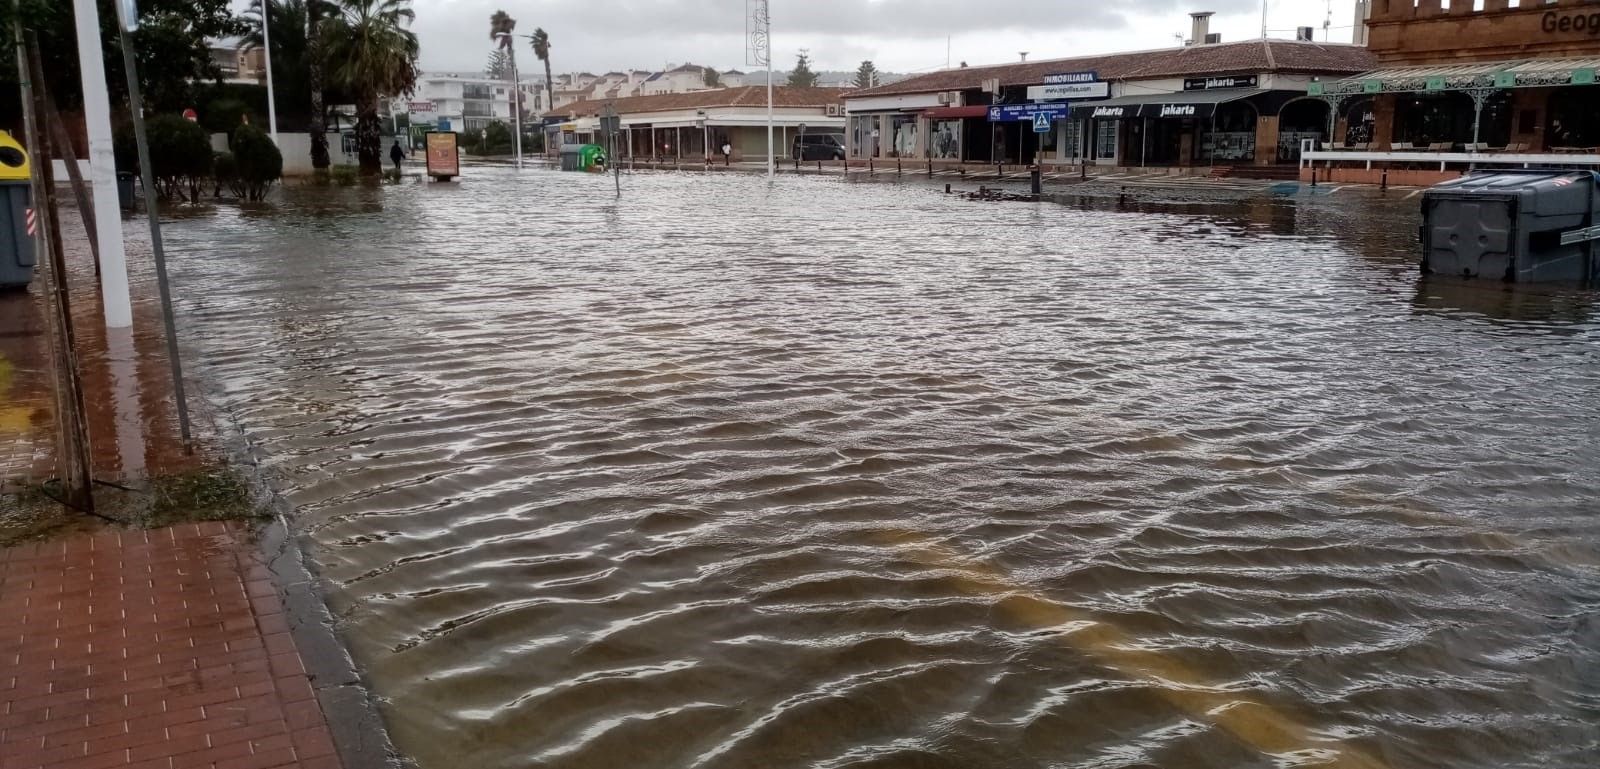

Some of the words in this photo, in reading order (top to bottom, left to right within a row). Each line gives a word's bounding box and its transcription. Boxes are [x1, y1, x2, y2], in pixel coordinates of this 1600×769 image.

[1541, 11, 1600, 35] Geog
[1044, 73, 1094, 84] INMOBILIARIA
[1204, 78, 1234, 89] jakarta
[1091, 106, 1124, 118] jakarta
[1160, 104, 1195, 117] jakarta
